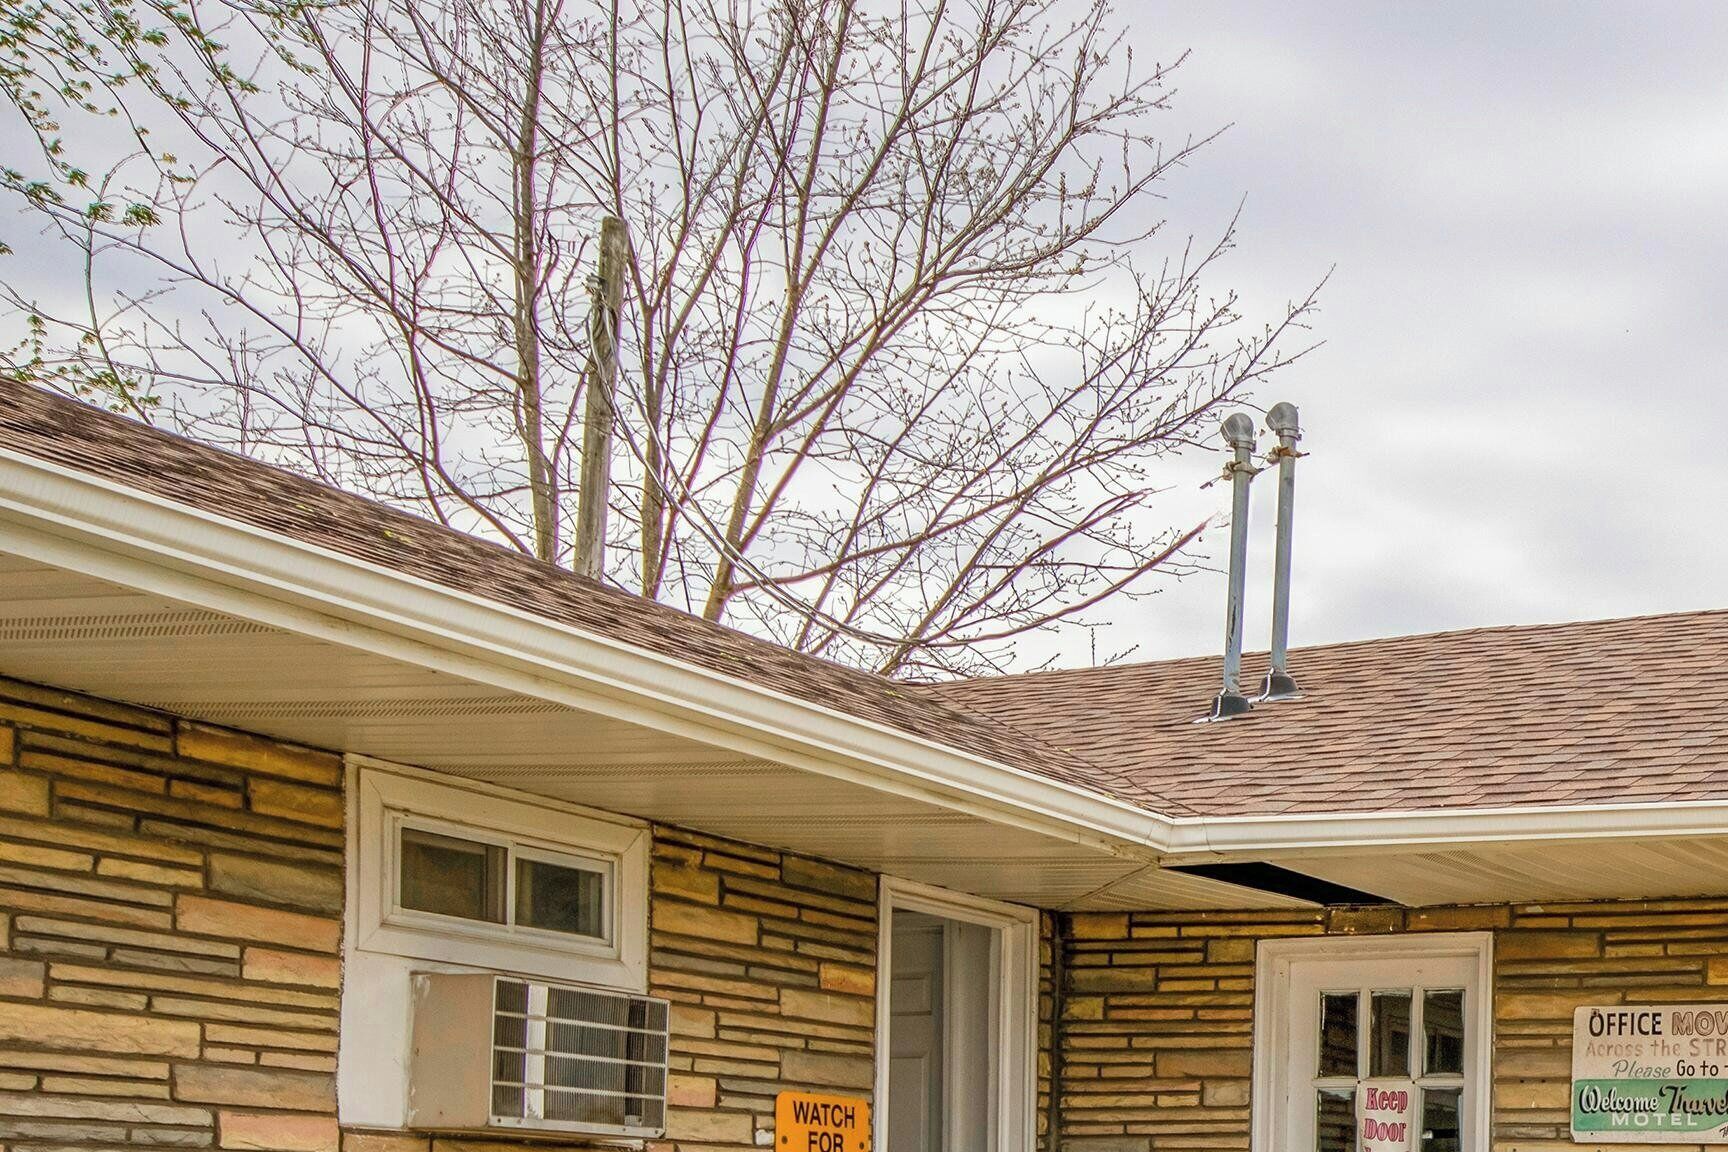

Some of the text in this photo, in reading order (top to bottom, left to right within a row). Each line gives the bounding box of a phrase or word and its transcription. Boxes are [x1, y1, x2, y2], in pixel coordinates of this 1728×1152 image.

[1589, 1012, 1662, 1037] OFFICE
[1585, 1041, 1643, 1057] Across
[1650, 1040, 1681, 1057] the
[1612, 1059, 1671, 1078] Please
[1677, 1059, 1695, 1077] Go
[1700, 1061, 1719, 1077] to
[1365, 1087, 1408, 1113] Keep
[1580, 1084, 1660, 1114] Welcome
[793, 1100, 855, 1129] WATCH
[1611, 1112, 1698, 1127] MOTEL
[1364, 1118, 1407, 1142] Door
